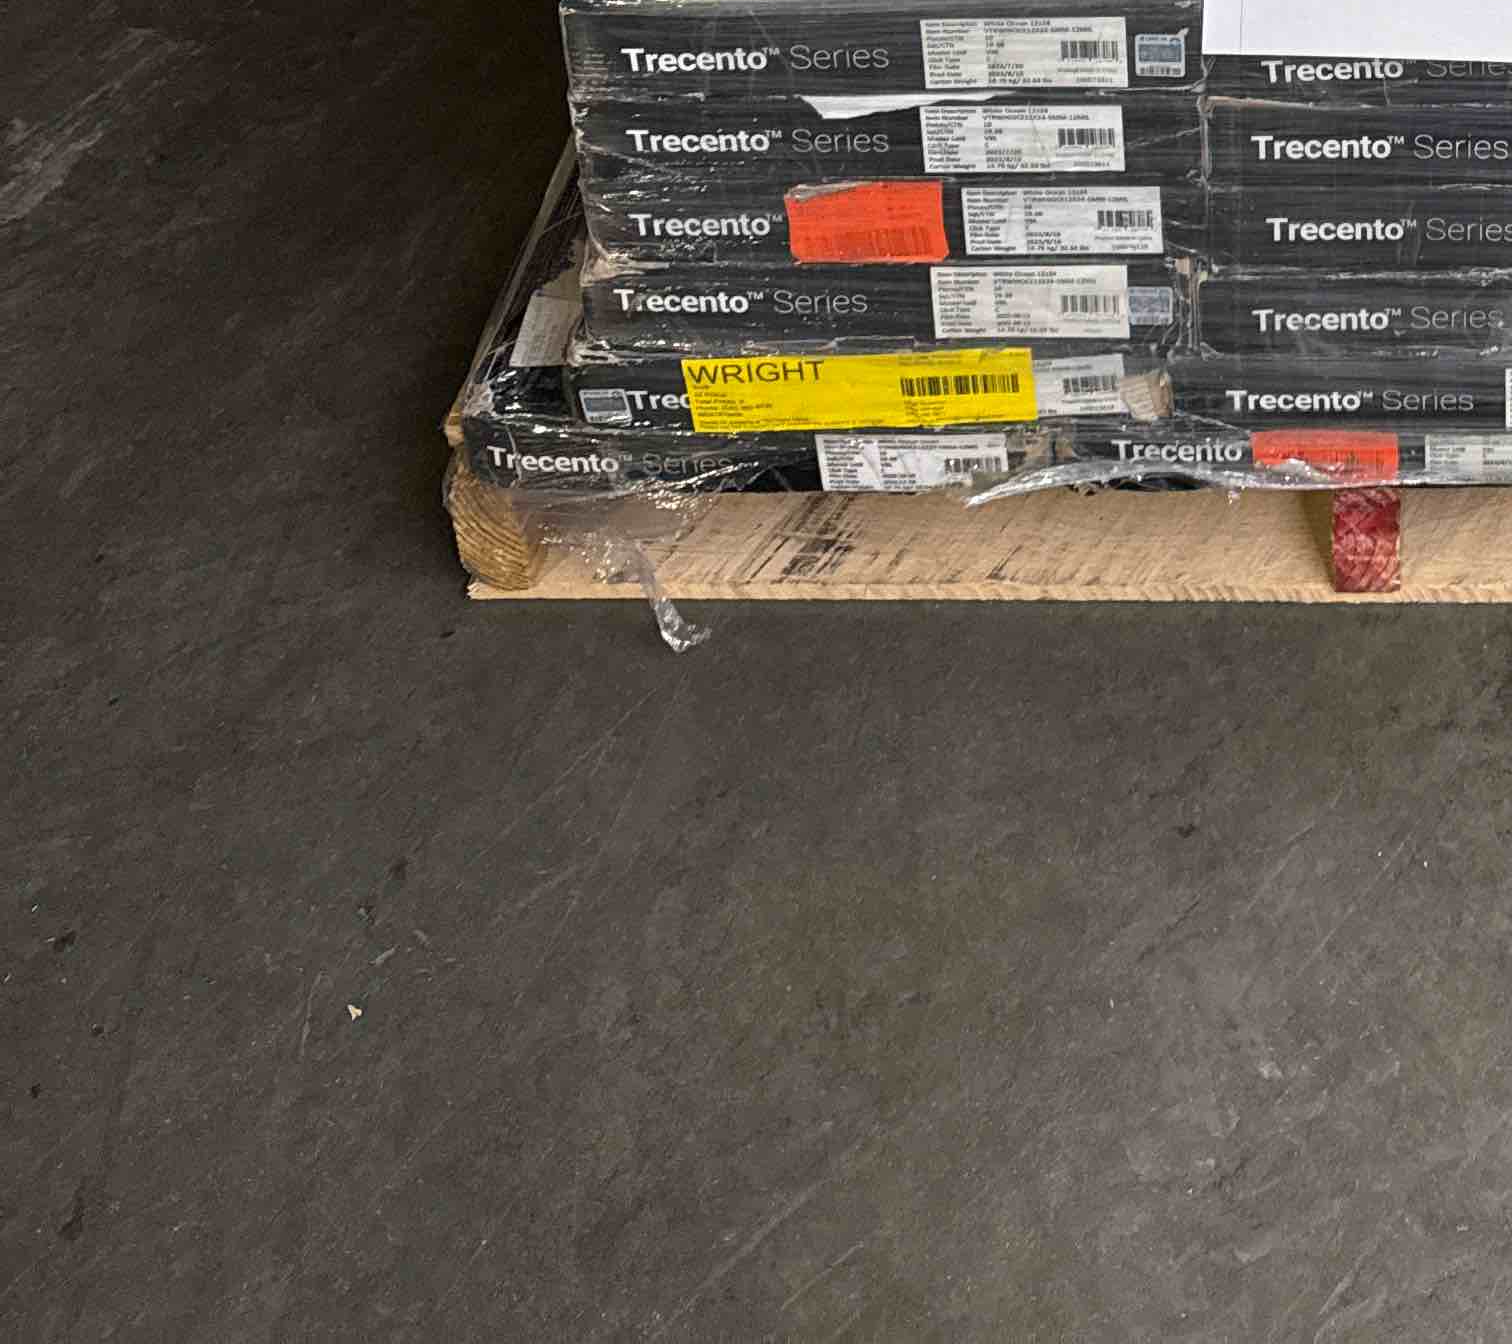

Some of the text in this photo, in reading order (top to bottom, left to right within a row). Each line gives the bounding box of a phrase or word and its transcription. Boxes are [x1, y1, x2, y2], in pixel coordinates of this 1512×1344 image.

[791, 43, 890, 72] Series
[791, 127, 890, 154] Series
[1413, 133, 1510, 160] Series
[773, 288, 868, 315] Series
[1409, 305, 1504, 330] Series
[686, 359, 826, 386] WRIGHT
[1382, 389, 1475, 411] Series
[642, 453, 734, 475] Series
[1112, 438, 1243, 464] Trecento
